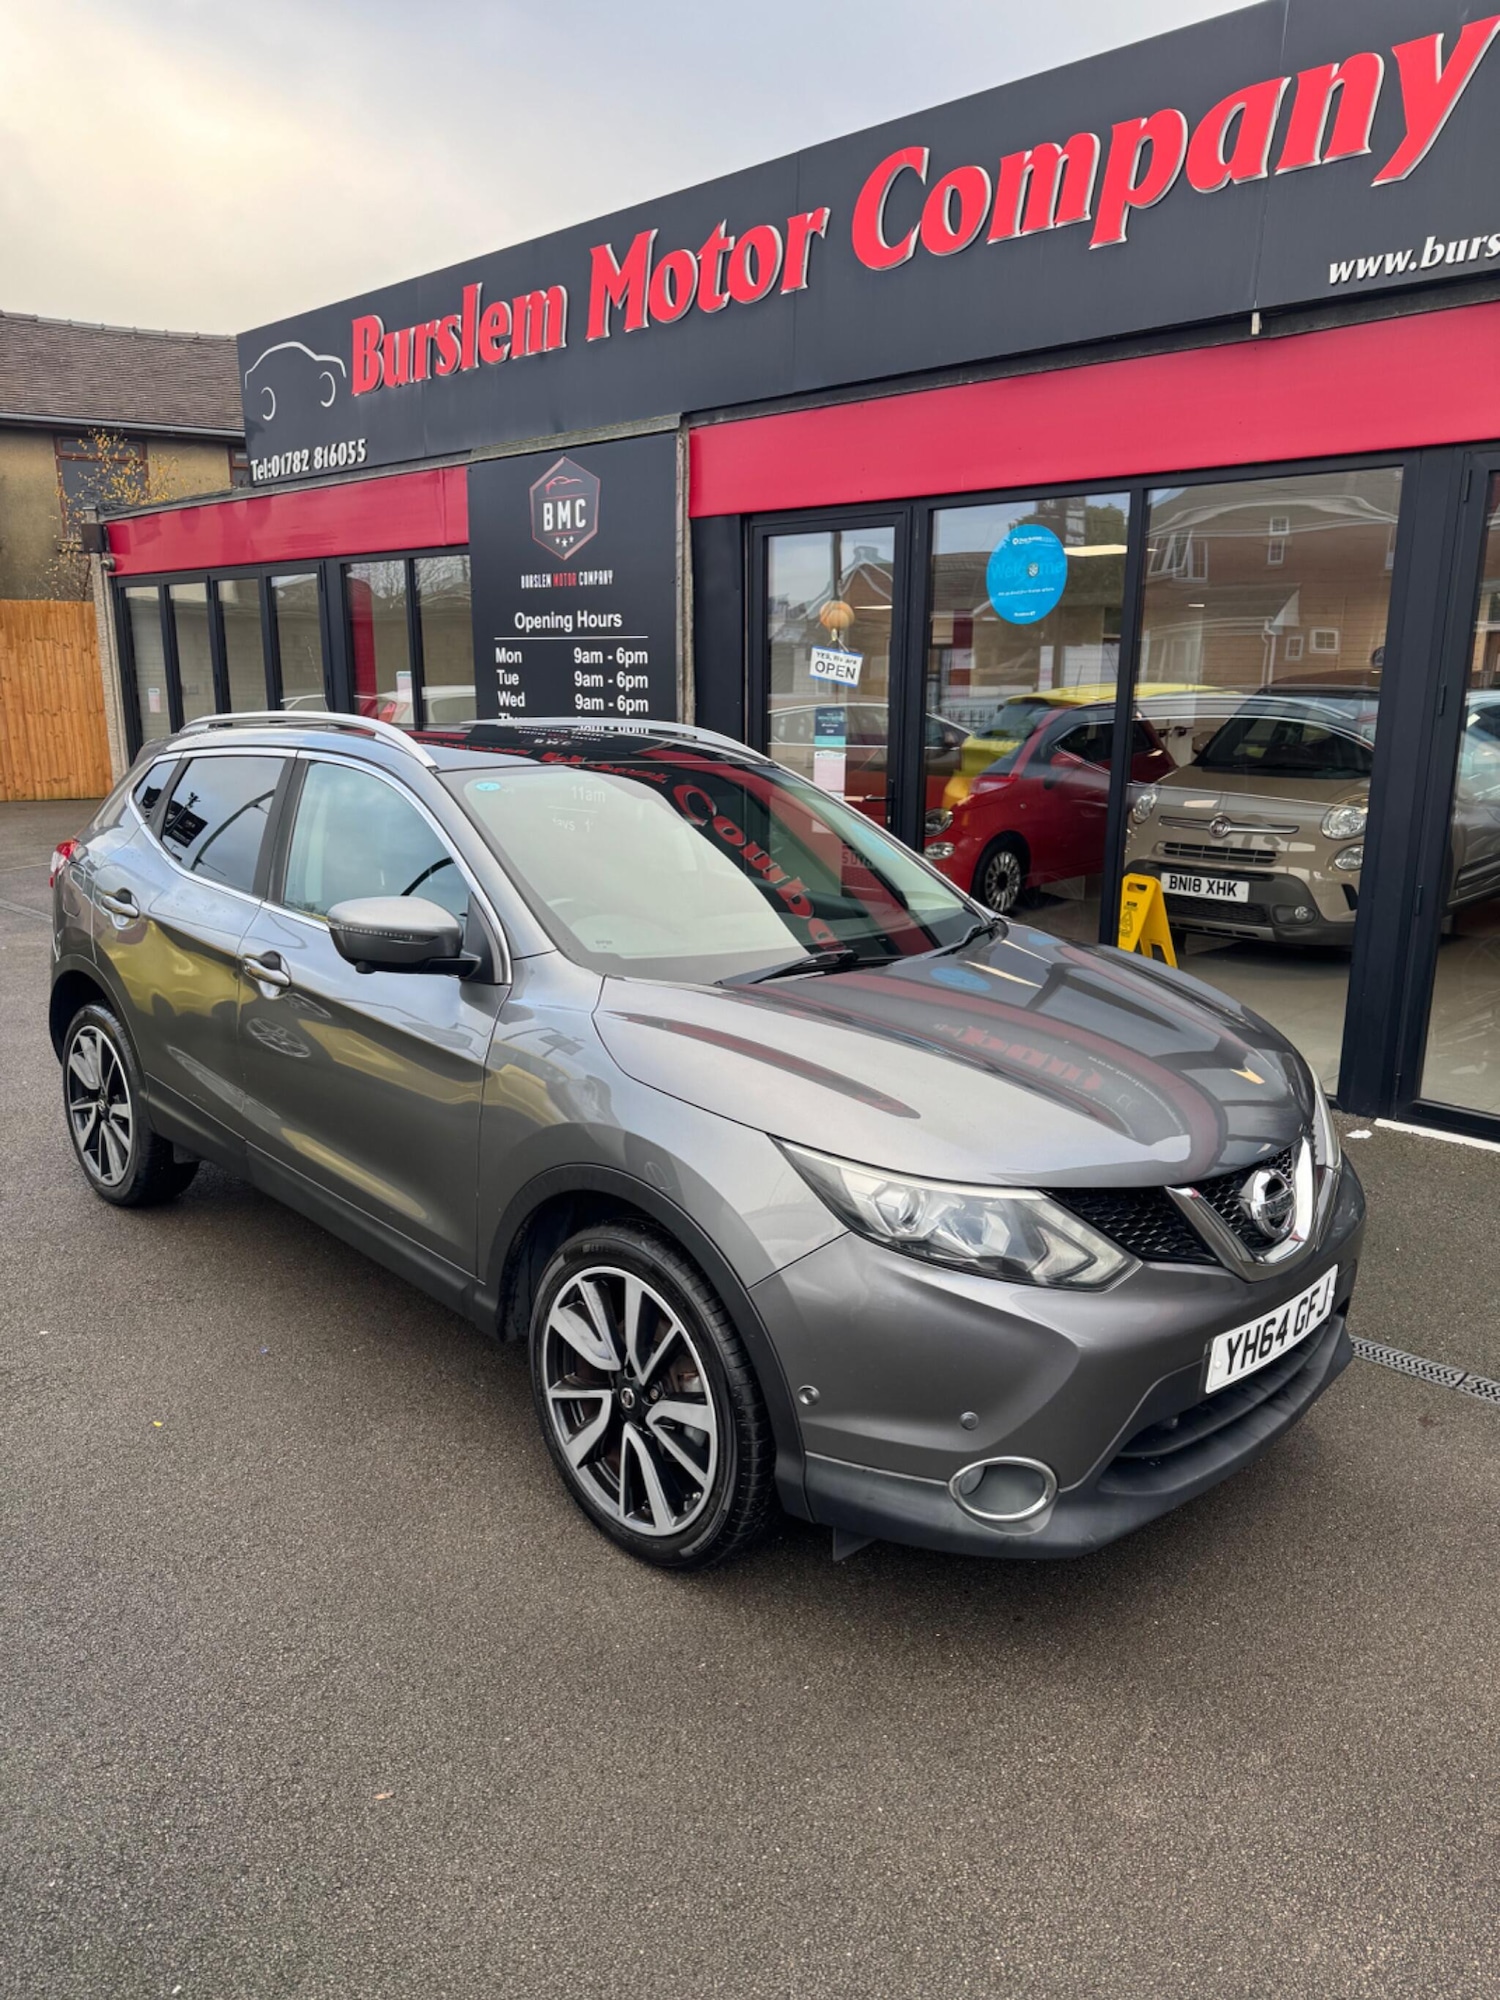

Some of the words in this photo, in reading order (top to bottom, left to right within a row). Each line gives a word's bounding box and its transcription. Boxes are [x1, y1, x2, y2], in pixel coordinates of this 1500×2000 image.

[351, 282, 567, 397] Burslem
[586, 207, 831, 342] Motor
[852, 14, 1500, 271] Company
[313, 438, 367, 470] 816055
[542, 498, 587, 532] BMC
[521, 573, 552, 589] BURSLEM
[552, 571, 577, 588] MOTOR
[578, 569, 614, 586] COMPANY
[514, 611, 573, 633] Opening
[577, 610, 623, 628] Hours
[495, 647, 523, 664] Mon
[573, 647, 604, 664] 9am
[616, 646, 649, 668] 6pm
[496, 669, 520, 685] Tue
[574, 670, 604, 688] 9am
[616, 670, 649, 692] 6pm
[814, 660, 857, 680] OPEN
[497, 690, 526, 708] Wed
[574, 693, 605, 711] 9am
[616, 694, 649, 716] 6pm
[1169, 875, 1202, 893] BN18
[1206, 879, 1238, 898] XHK
[1226, 1308, 1291, 1376] YH64
[1293, 1276, 1332, 1338] GFJ
